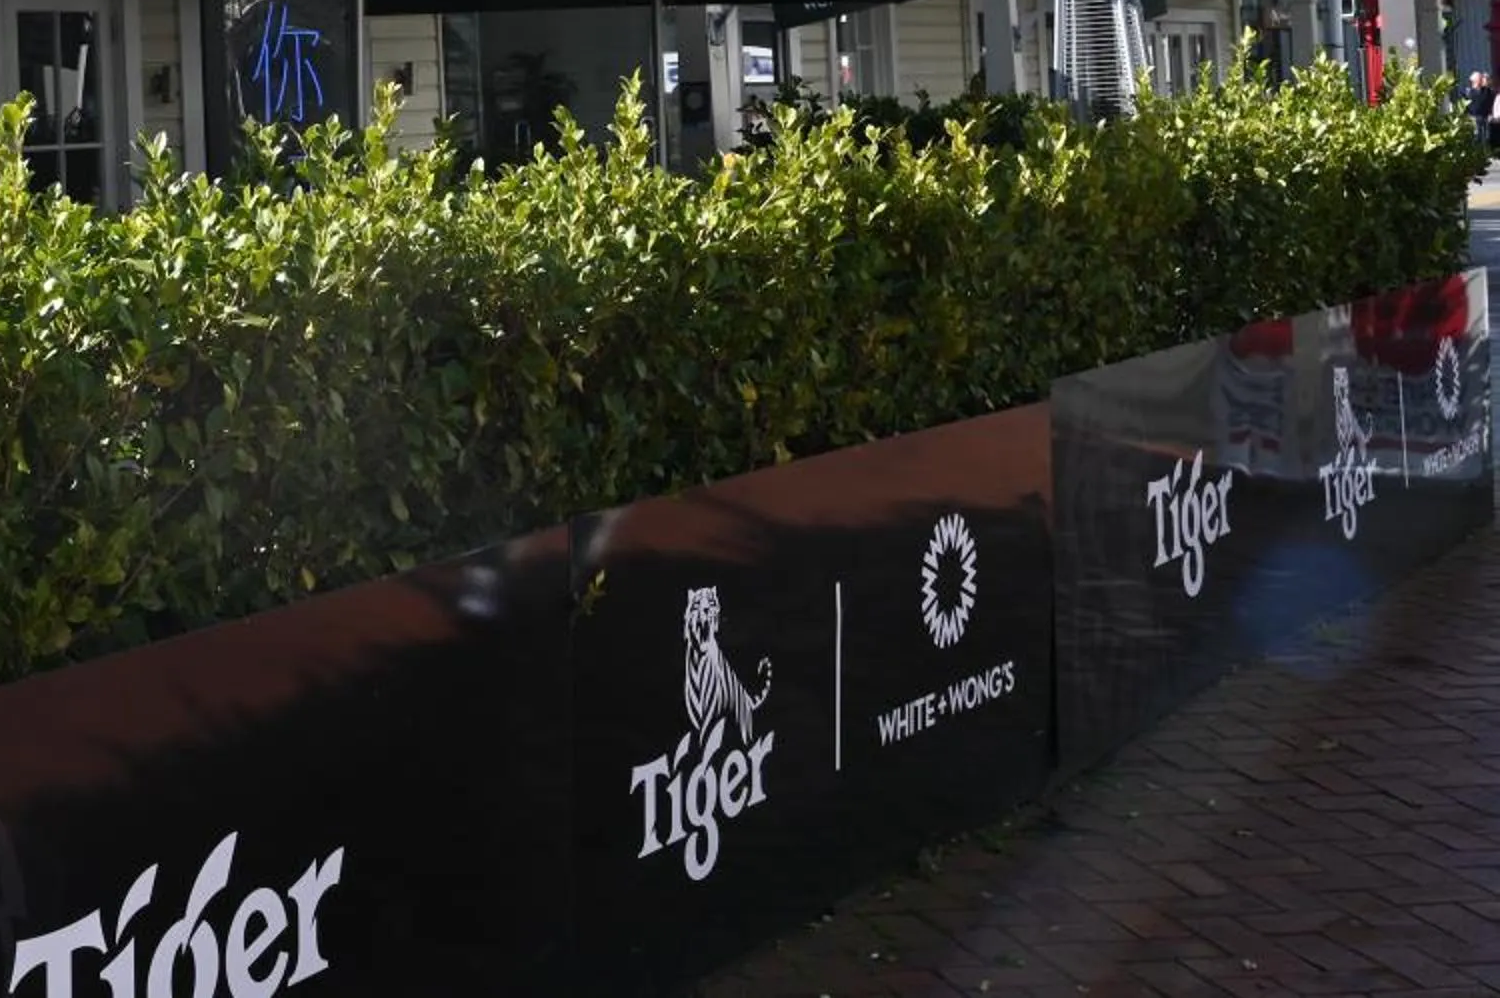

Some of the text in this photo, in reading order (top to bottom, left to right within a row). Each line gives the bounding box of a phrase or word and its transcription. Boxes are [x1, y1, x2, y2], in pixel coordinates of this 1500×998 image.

[1147, 449, 1233, 597] Tiger
[1318, 448, 1376, 540] Tiger
[629, 718, 774, 882] Tiger
